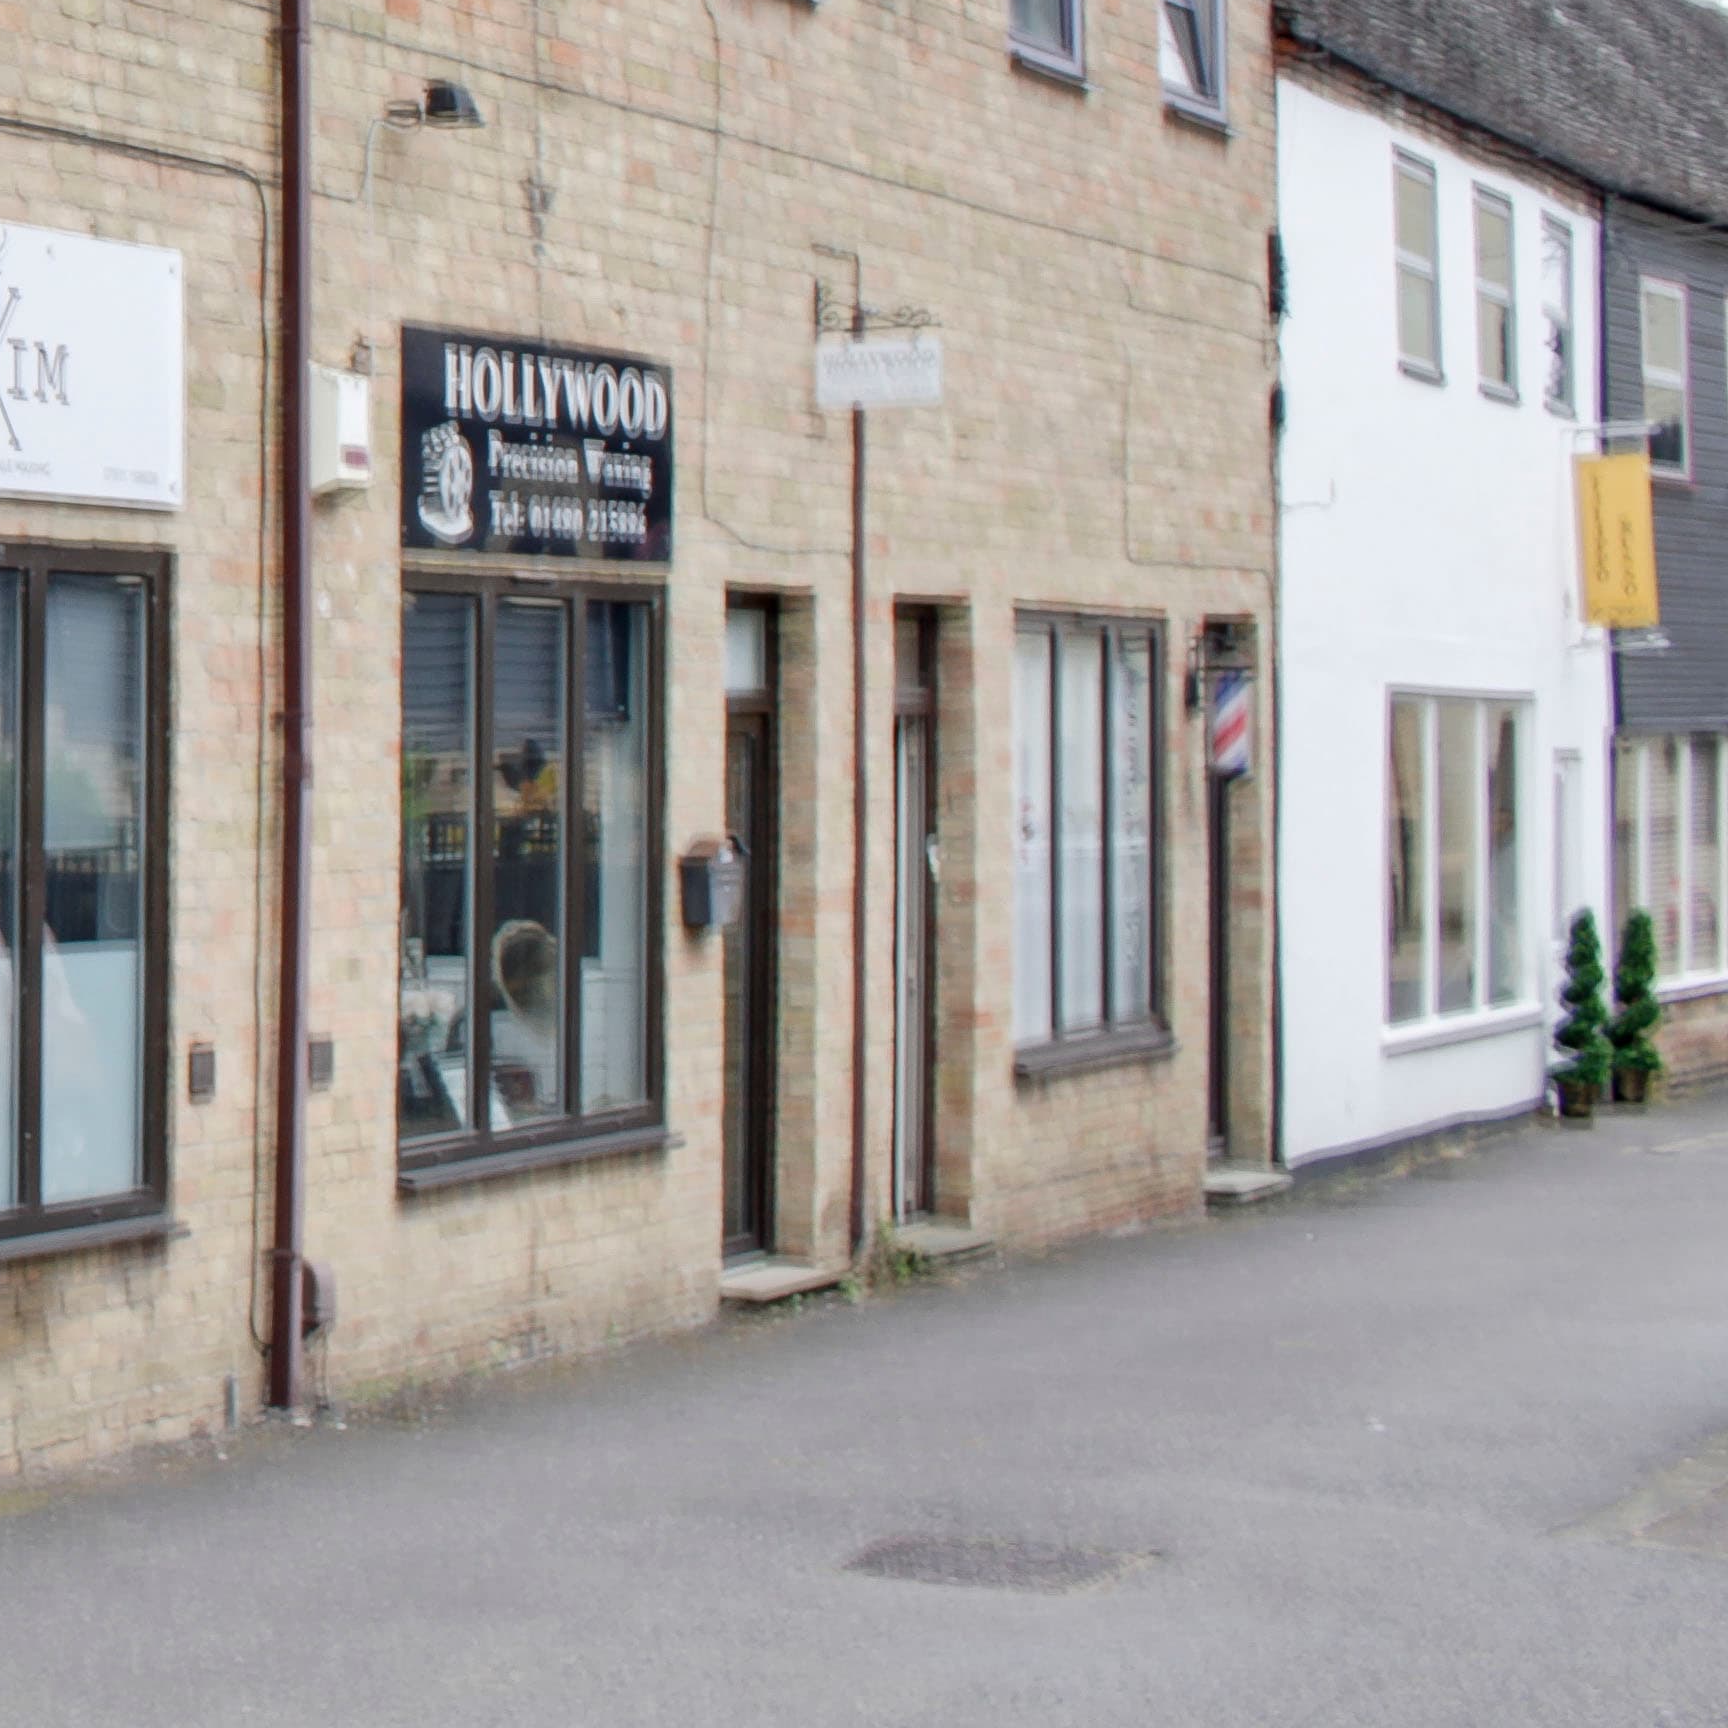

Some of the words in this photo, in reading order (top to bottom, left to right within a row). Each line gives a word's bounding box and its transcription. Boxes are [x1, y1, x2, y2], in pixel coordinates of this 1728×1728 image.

[445, 343, 668, 440] HOLLYWOOD
[488, 429, 579, 484] Precision
[583, 438, 652, 500] Waxing
